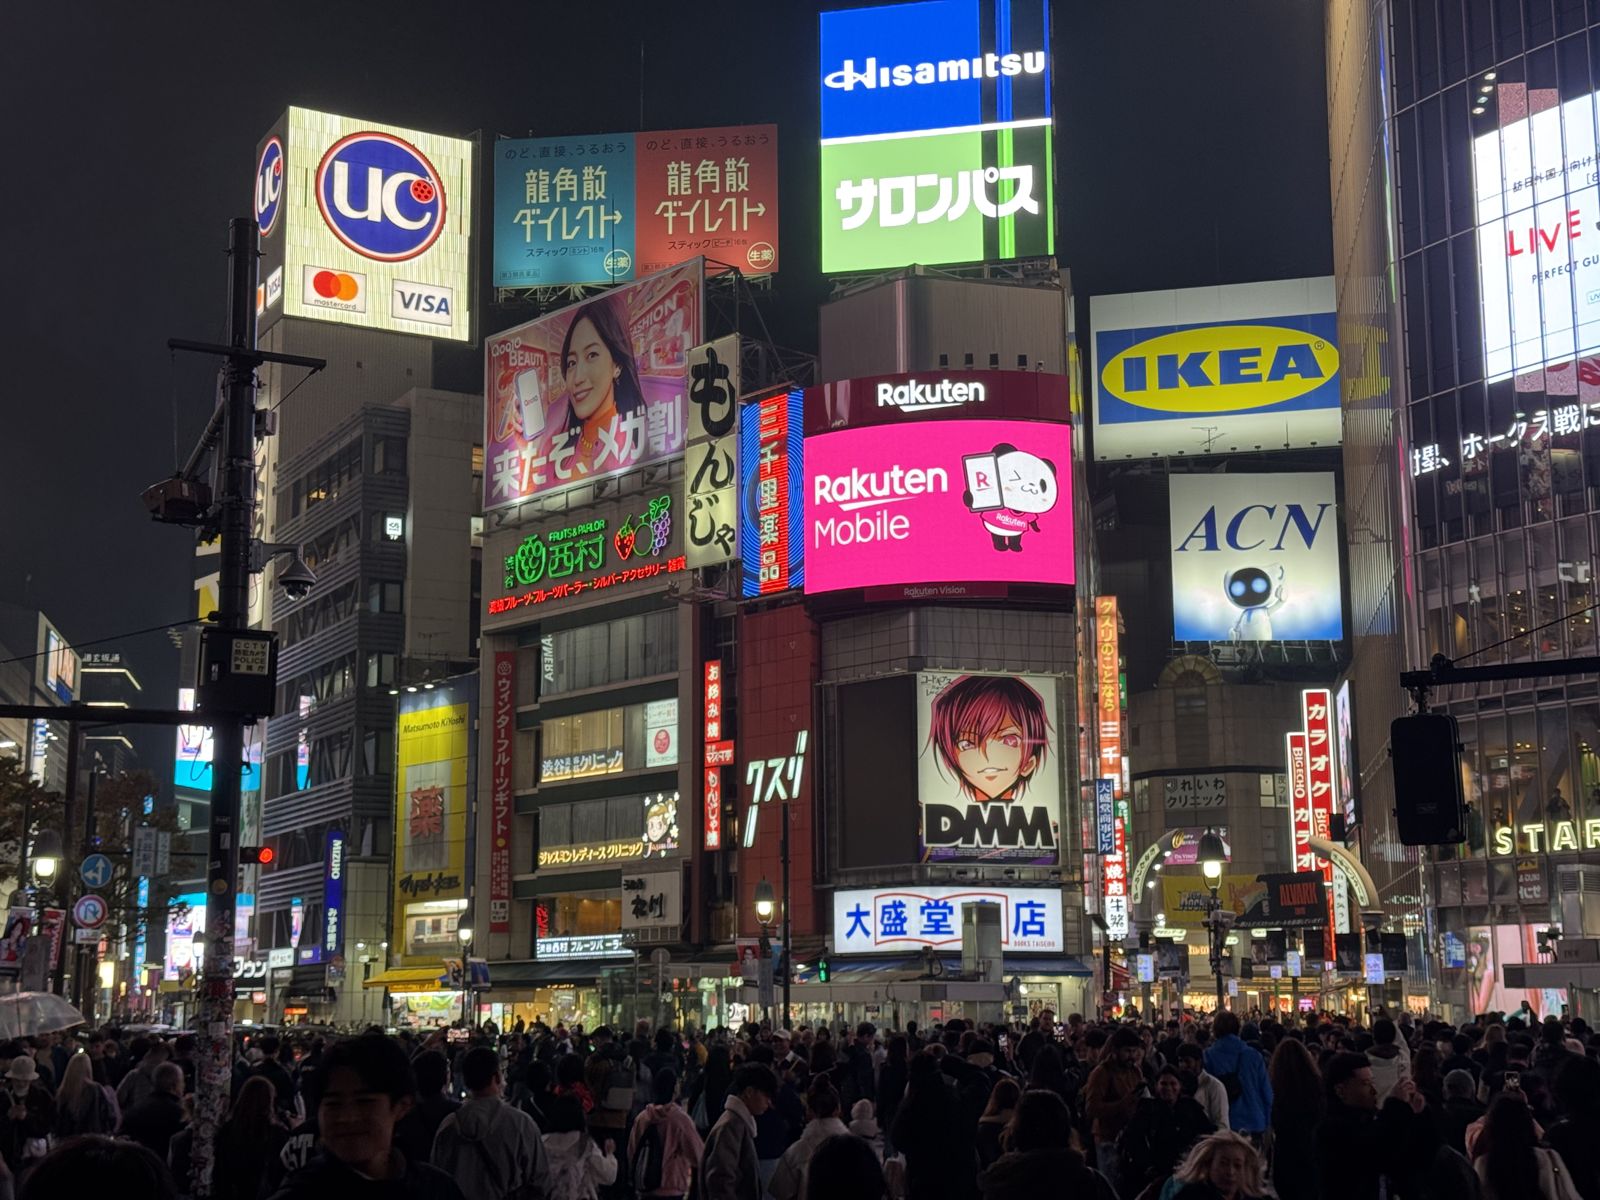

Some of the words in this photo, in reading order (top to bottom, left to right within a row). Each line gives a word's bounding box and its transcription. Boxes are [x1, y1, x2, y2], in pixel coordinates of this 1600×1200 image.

[504, 142, 627, 159] のど、直接、うるおう
[646, 133, 770, 151] のど、直接、うるおう
[525, 165, 607, 204] 龍角散
[667, 157, 750, 196] 龍角散
[655, 197, 766, 235] ダイレクト
[835, 165, 1039, 230] サロンパス
[513, 204, 623, 243] ダイレクト
[1506, 209, 1582, 257] LIVE
[526, 246, 569, 258] スティック
[668, 238, 711, 251] スティック
[749, 248, 774, 263] 生薬
[1531, 260, 1579, 285] PERFECT
[313, 299, 358, 311] mastercard
[395, 289, 450, 317] VISA
[509, 350, 545, 369] BEAUTY
[1123, 342, 1324, 393] IKEA
[877, 379, 985, 411] Rakuten
[688, 346, 736, 557] もんじゃ
[759, 402, 780, 583] 三千里薬品
[814, 464, 948, 509] Rakuten
[976, 471, 991, 487] R
[814, 511, 910, 549] Mobile
[995, 512, 1027, 529] Rakuten
[1174, 504, 1332, 552] ACN
[548, 534, 605, 579] 西村
[904, 586, 938, 597] Rakuten
[940, 585, 966, 595] Vision
[234, 656, 265, 665] POLICE
[1100, 601, 1116, 711] クスリのことなら
[707, 664, 719, 738] お好み焼
[403, 721, 441, 734] Matsumoto
[495, 677, 510, 835] ウィンターフルーツギフト
[1308, 704, 1331, 798] カラオケ
[1167, 793, 1225, 808] クリニック
[1181, 778, 1225, 792] れいわ
[410, 786, 444, 838] 薬
[925, 803, 1055, 846] DMM
[1495, 819, 1600, 855] STAR
[331, 839, 343, 880] MIZUHO
[1279, 882, 1319, 907] ALVARK
[845, 899, 1047, 939] 大盛堂店
[1013, 940, 1031, 948] BOOKS
